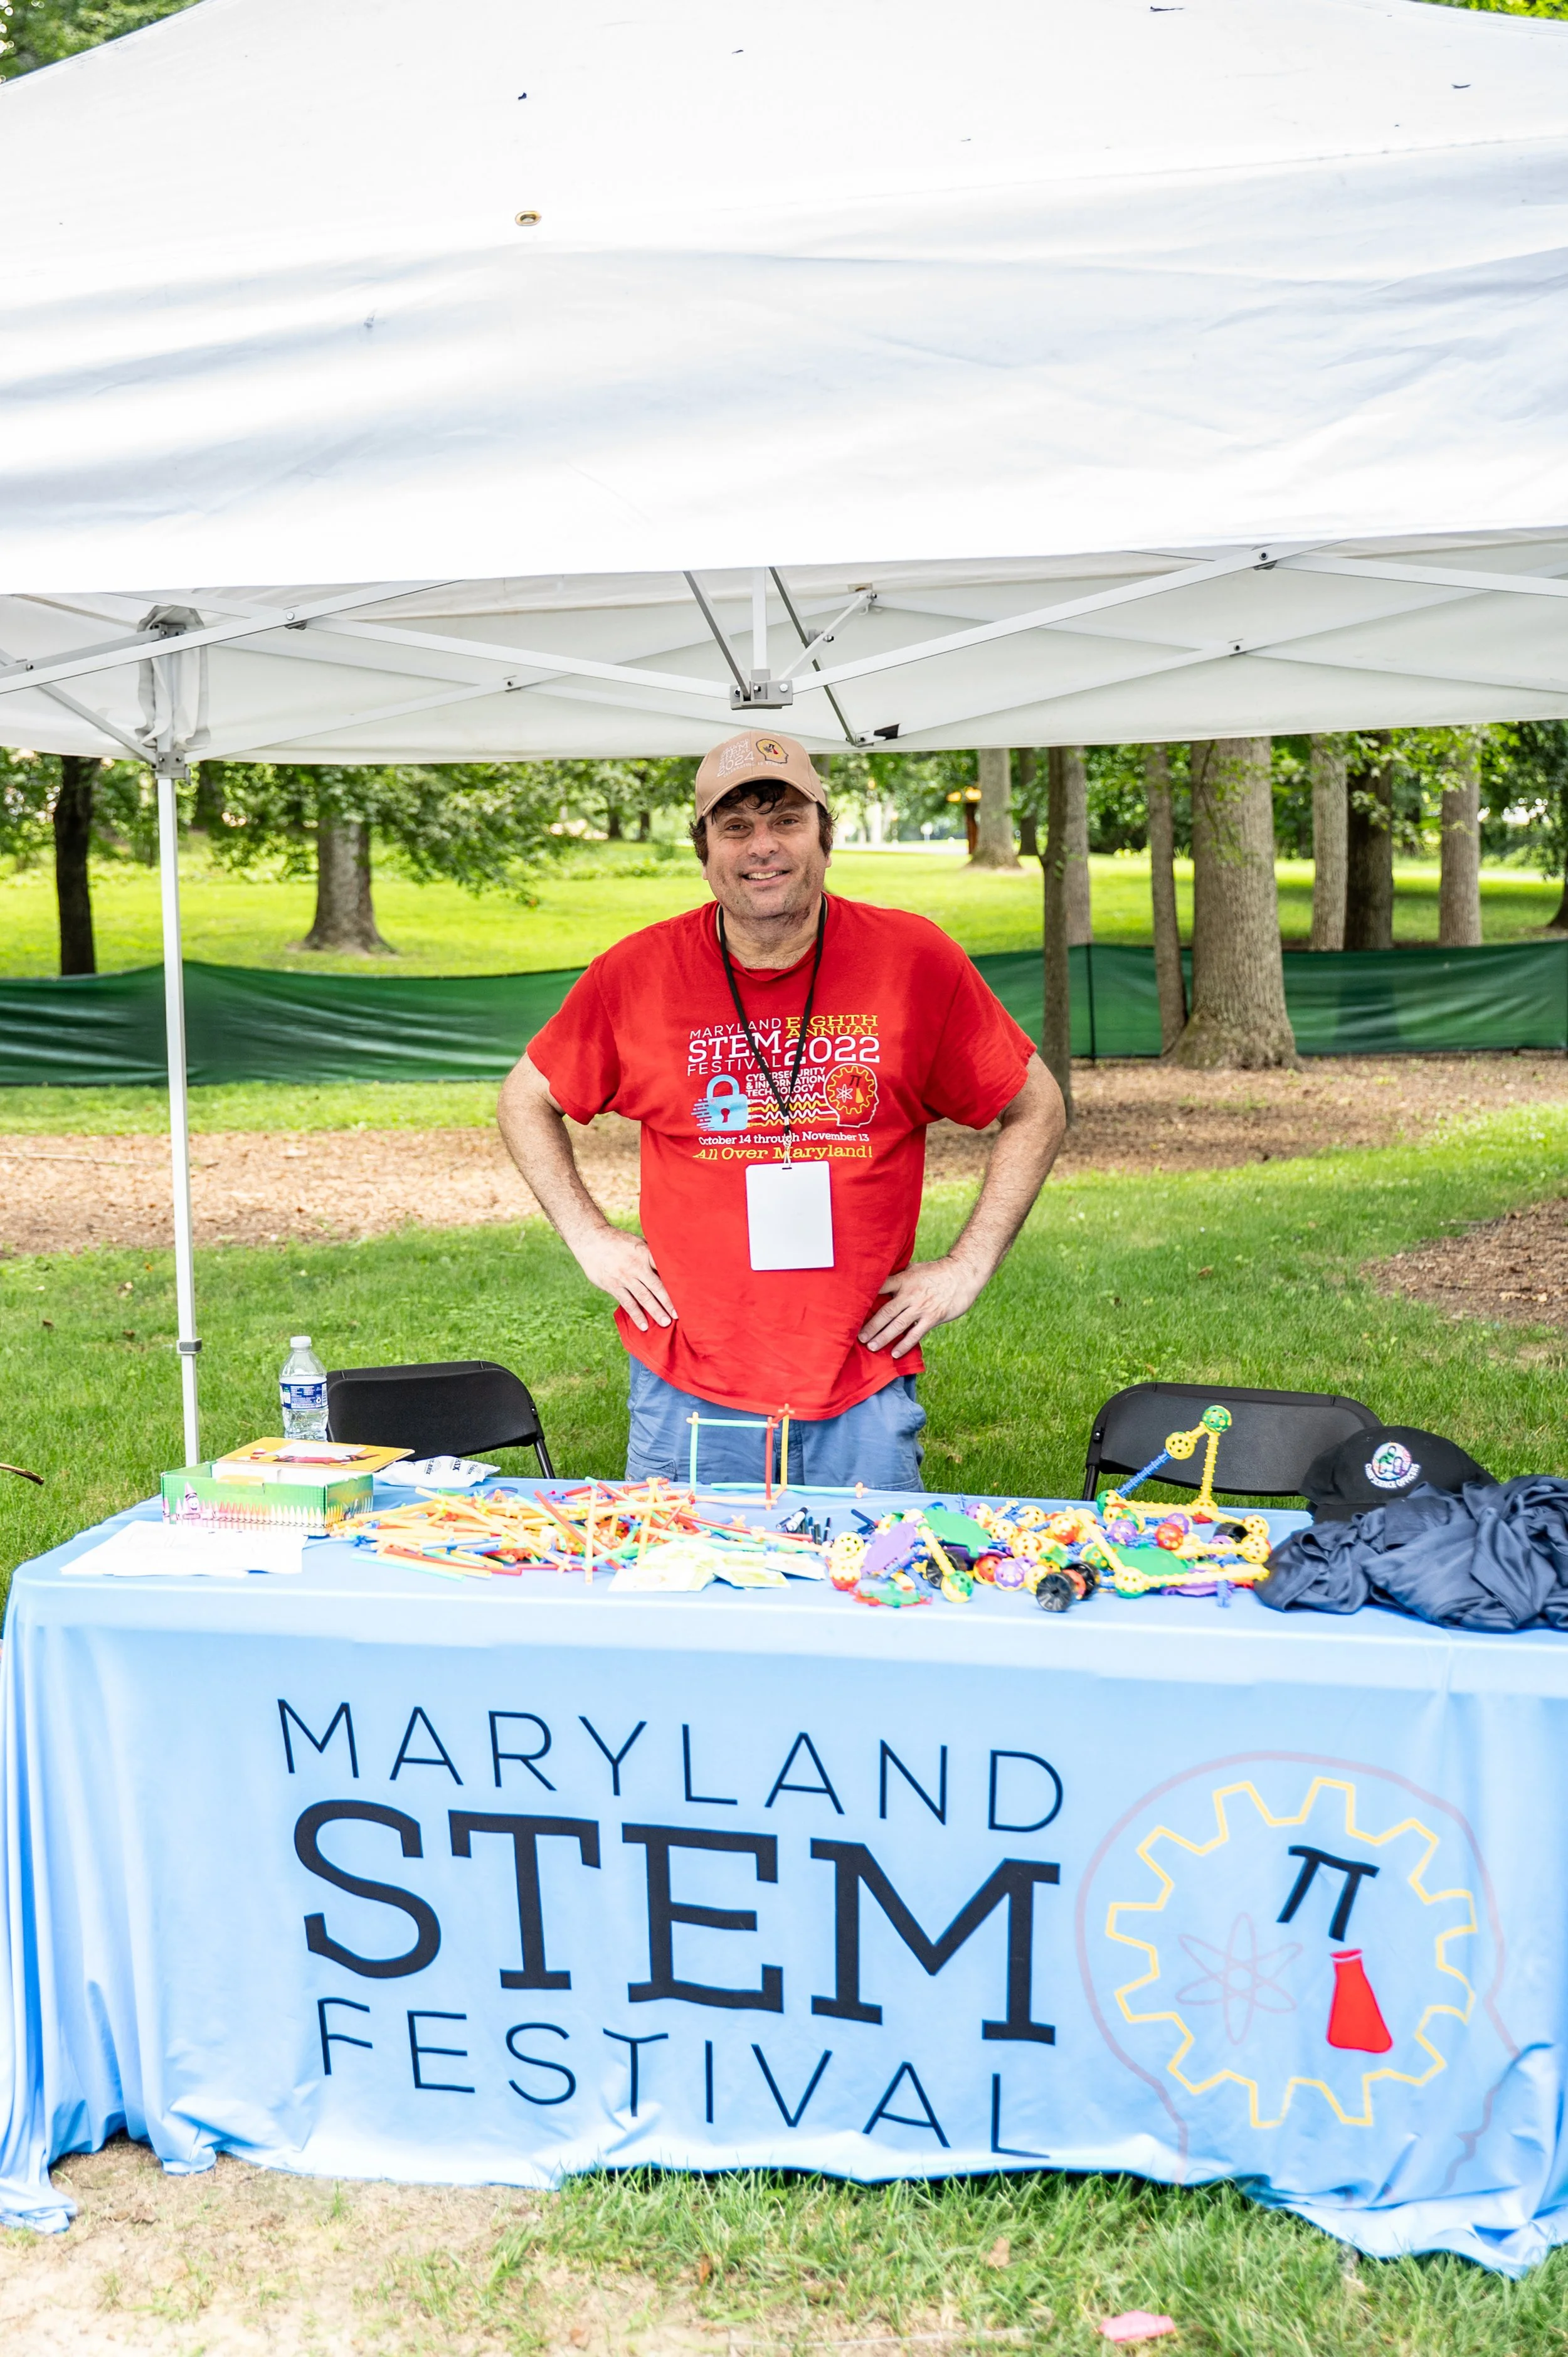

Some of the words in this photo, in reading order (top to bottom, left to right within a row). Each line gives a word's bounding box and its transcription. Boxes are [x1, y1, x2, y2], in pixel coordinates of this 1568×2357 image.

[717, 751, 755, 777] 2024
[690, 1017, 781, 1039] MARYLAND
[785, 1014, 878, 1029] EGHTH
[688, 1030, 782, 1064] STEM
[784, 1035, 881, 1066] 2022
[745, 1066, 826, 1082] CYBRSEURITY
[746, 1082, 753, 1090] &
[699, 1135, 738, 1146] October
[738, 1134, 752, 1145] 14
[753, 1132, 800, 1145] throuh
[802, 1131, 856, 1142] November
[858, 1133, 870, 1142] 13
[692, 1148, 718, 1160] All
[721, 1147, 769, 1160] Over
[772, 1143, 873, 1160] Maryland!
[277, 1697, 1064, 1833] MARYLAND
[292, 1798, 1062, 2047] STEM
[315, 1996, 1051, 2159] FESTIVAL
